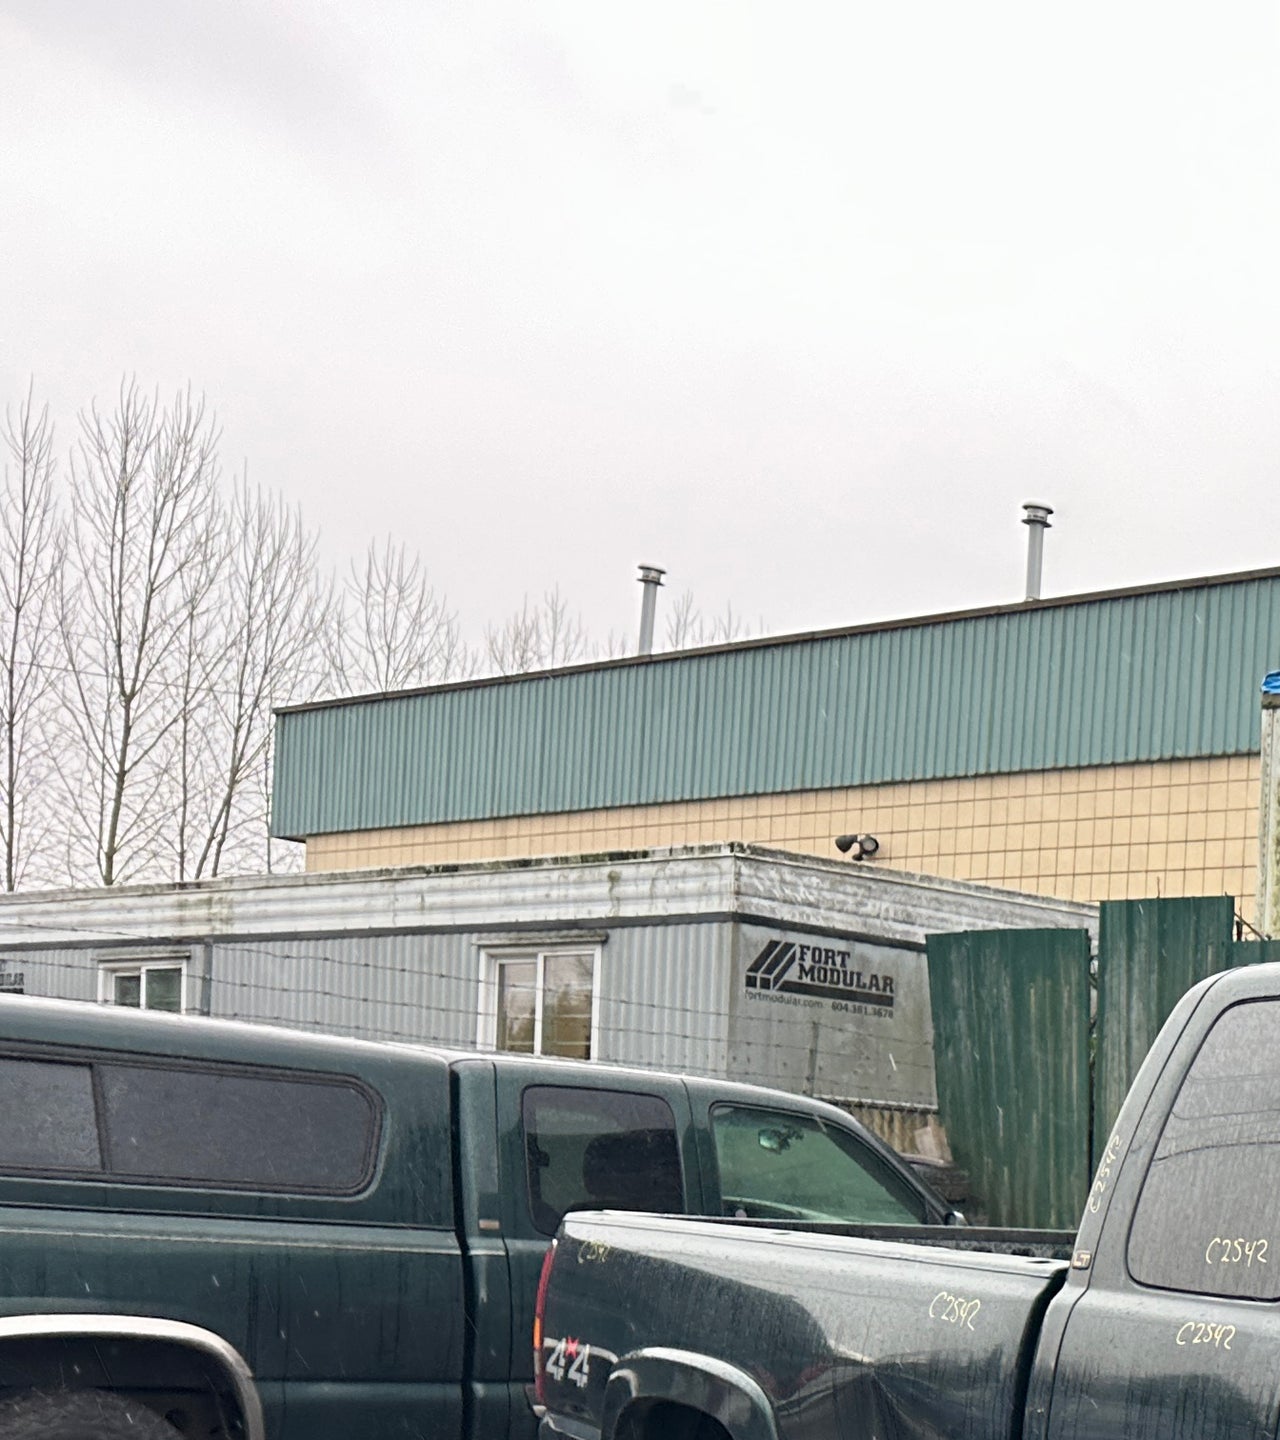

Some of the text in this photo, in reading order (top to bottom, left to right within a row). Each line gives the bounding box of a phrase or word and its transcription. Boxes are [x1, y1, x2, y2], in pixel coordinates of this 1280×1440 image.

[798, 944, 851, 968] FORT
[797, 963, 895, 994] MODULAR
[1205, 1237, 1268, 1268] C2542
[929, 1291, 981, 1331] C2542
[1176, 1321, 1236, 1350] C2542
